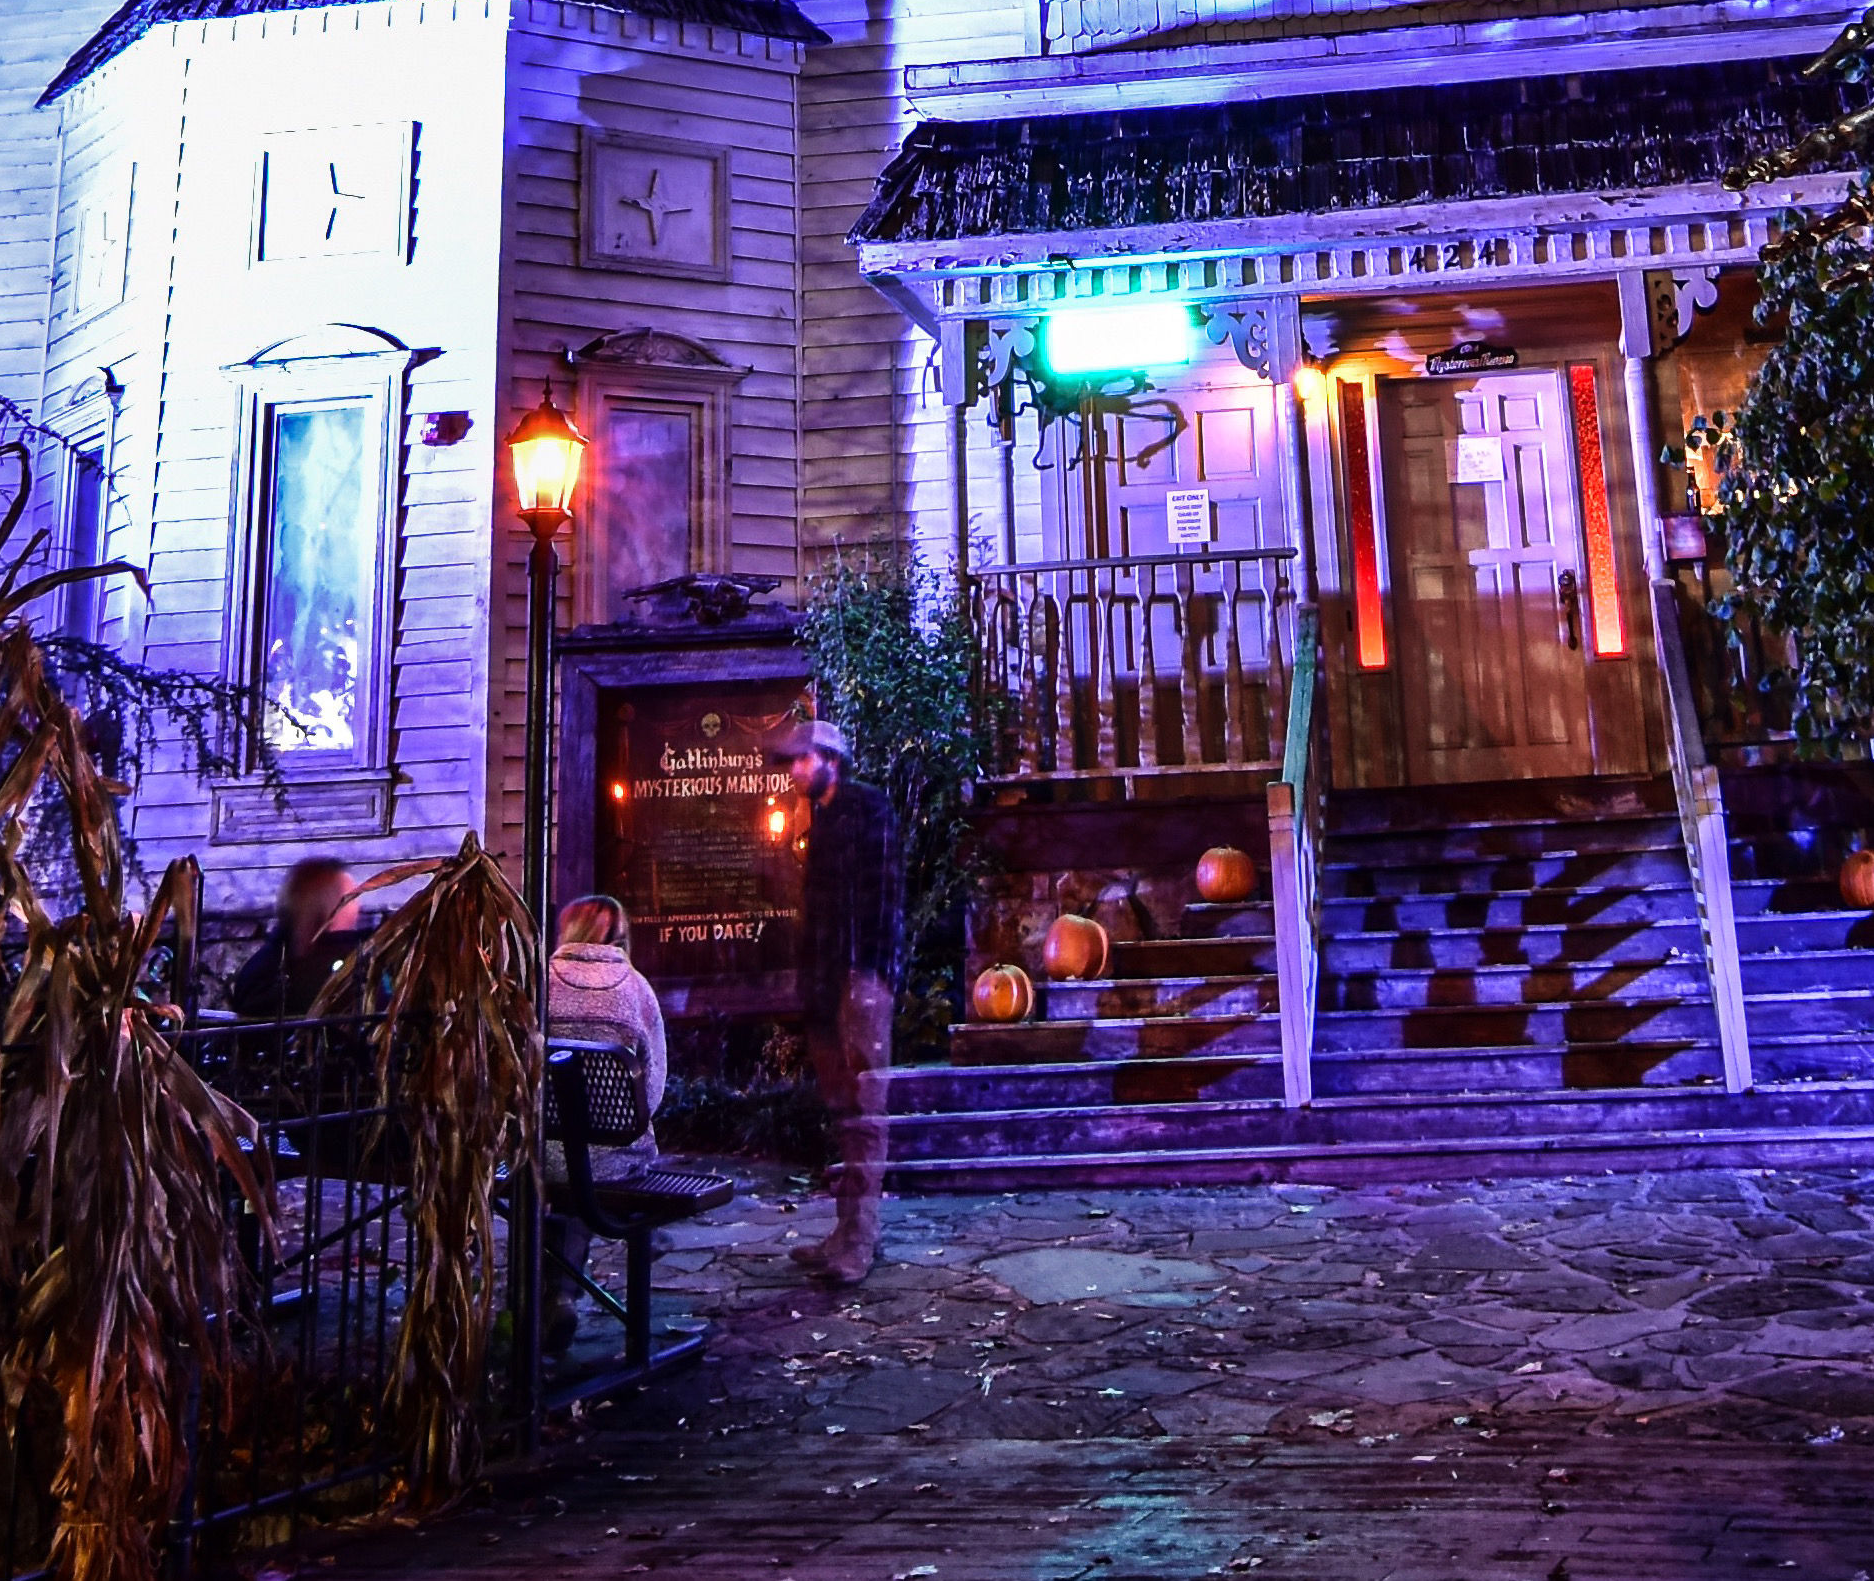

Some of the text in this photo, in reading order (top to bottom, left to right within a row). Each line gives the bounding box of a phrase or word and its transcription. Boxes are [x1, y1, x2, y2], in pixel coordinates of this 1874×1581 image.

[1408, 239, 1497, 272] 424
[659, 741, 763, 776] Gatlinburg's
[634, 772, 792, 799] MYSTERIOUS MANSION
[658, 920, 766, 943] IF YOU DARE!
